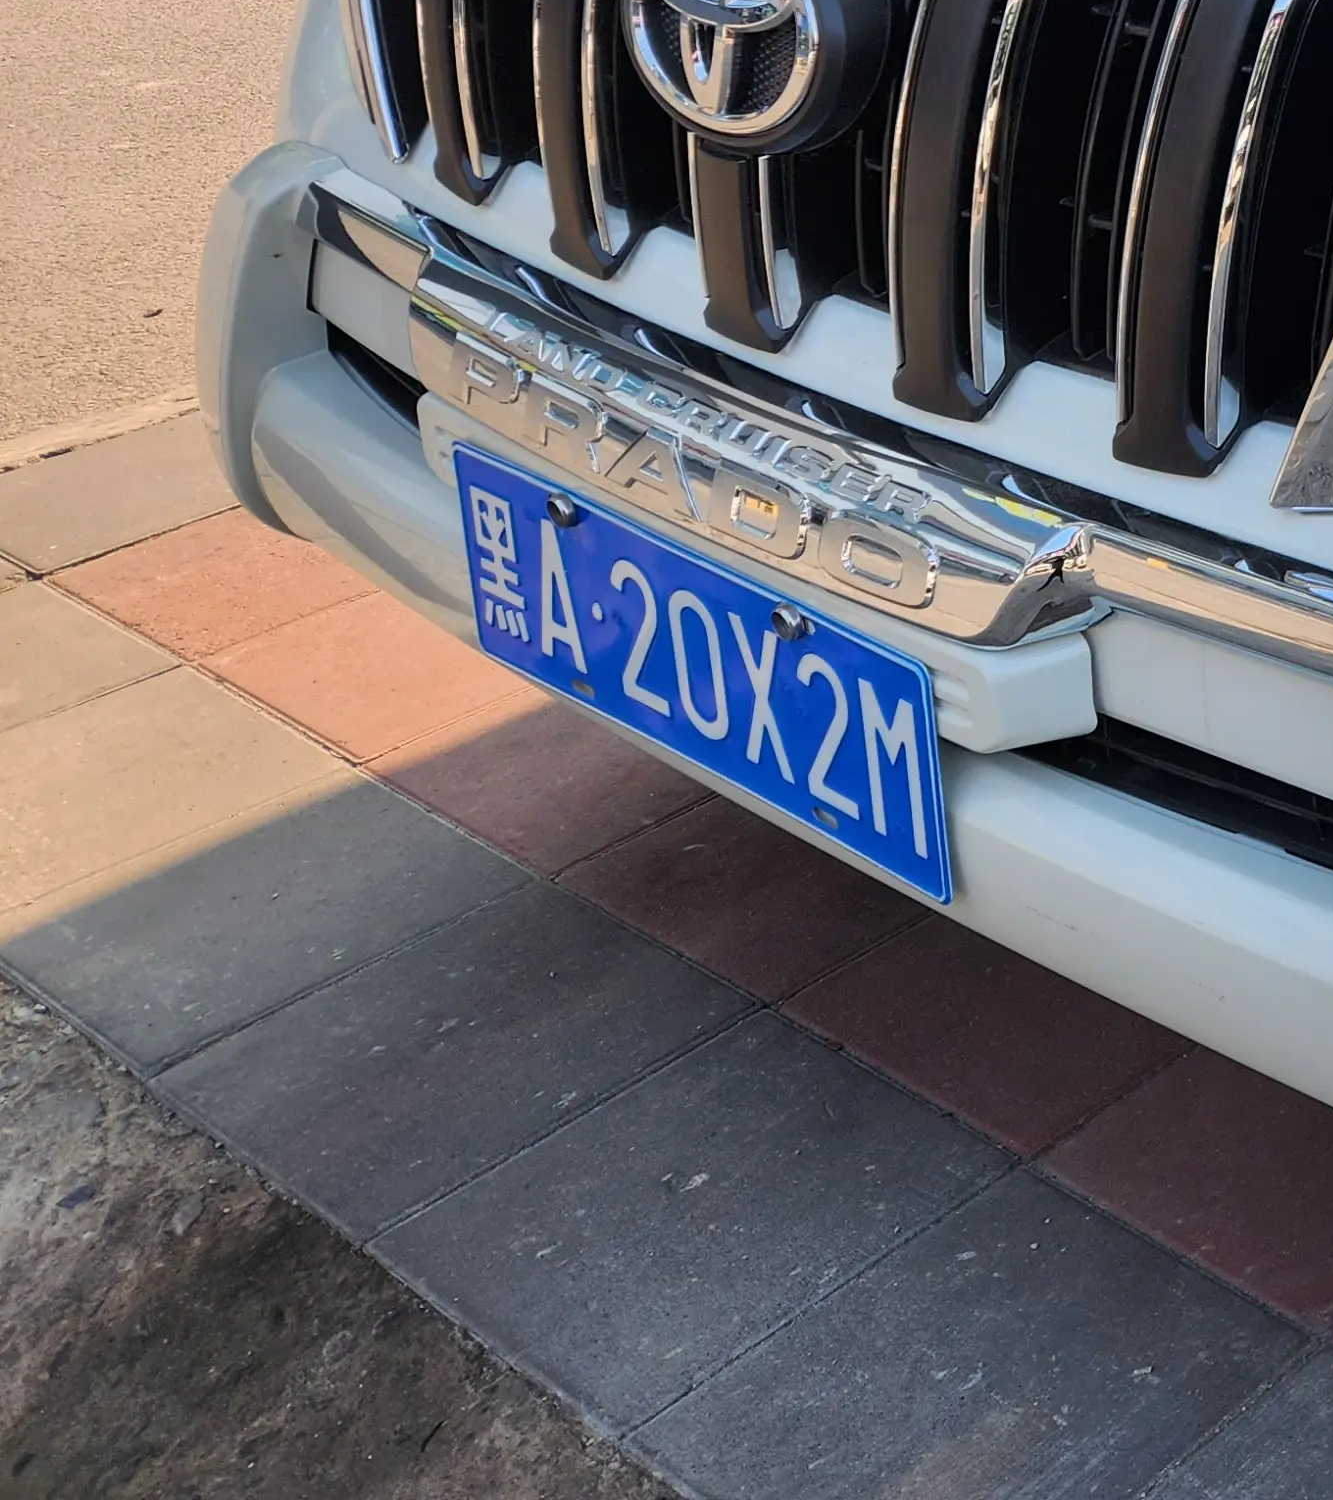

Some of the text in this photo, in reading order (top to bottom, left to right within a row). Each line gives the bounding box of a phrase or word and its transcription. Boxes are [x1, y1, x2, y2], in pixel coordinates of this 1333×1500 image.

[451, 332, 940, 609] PRADO
[484, 311, 932, 523] LAND CRUISER
